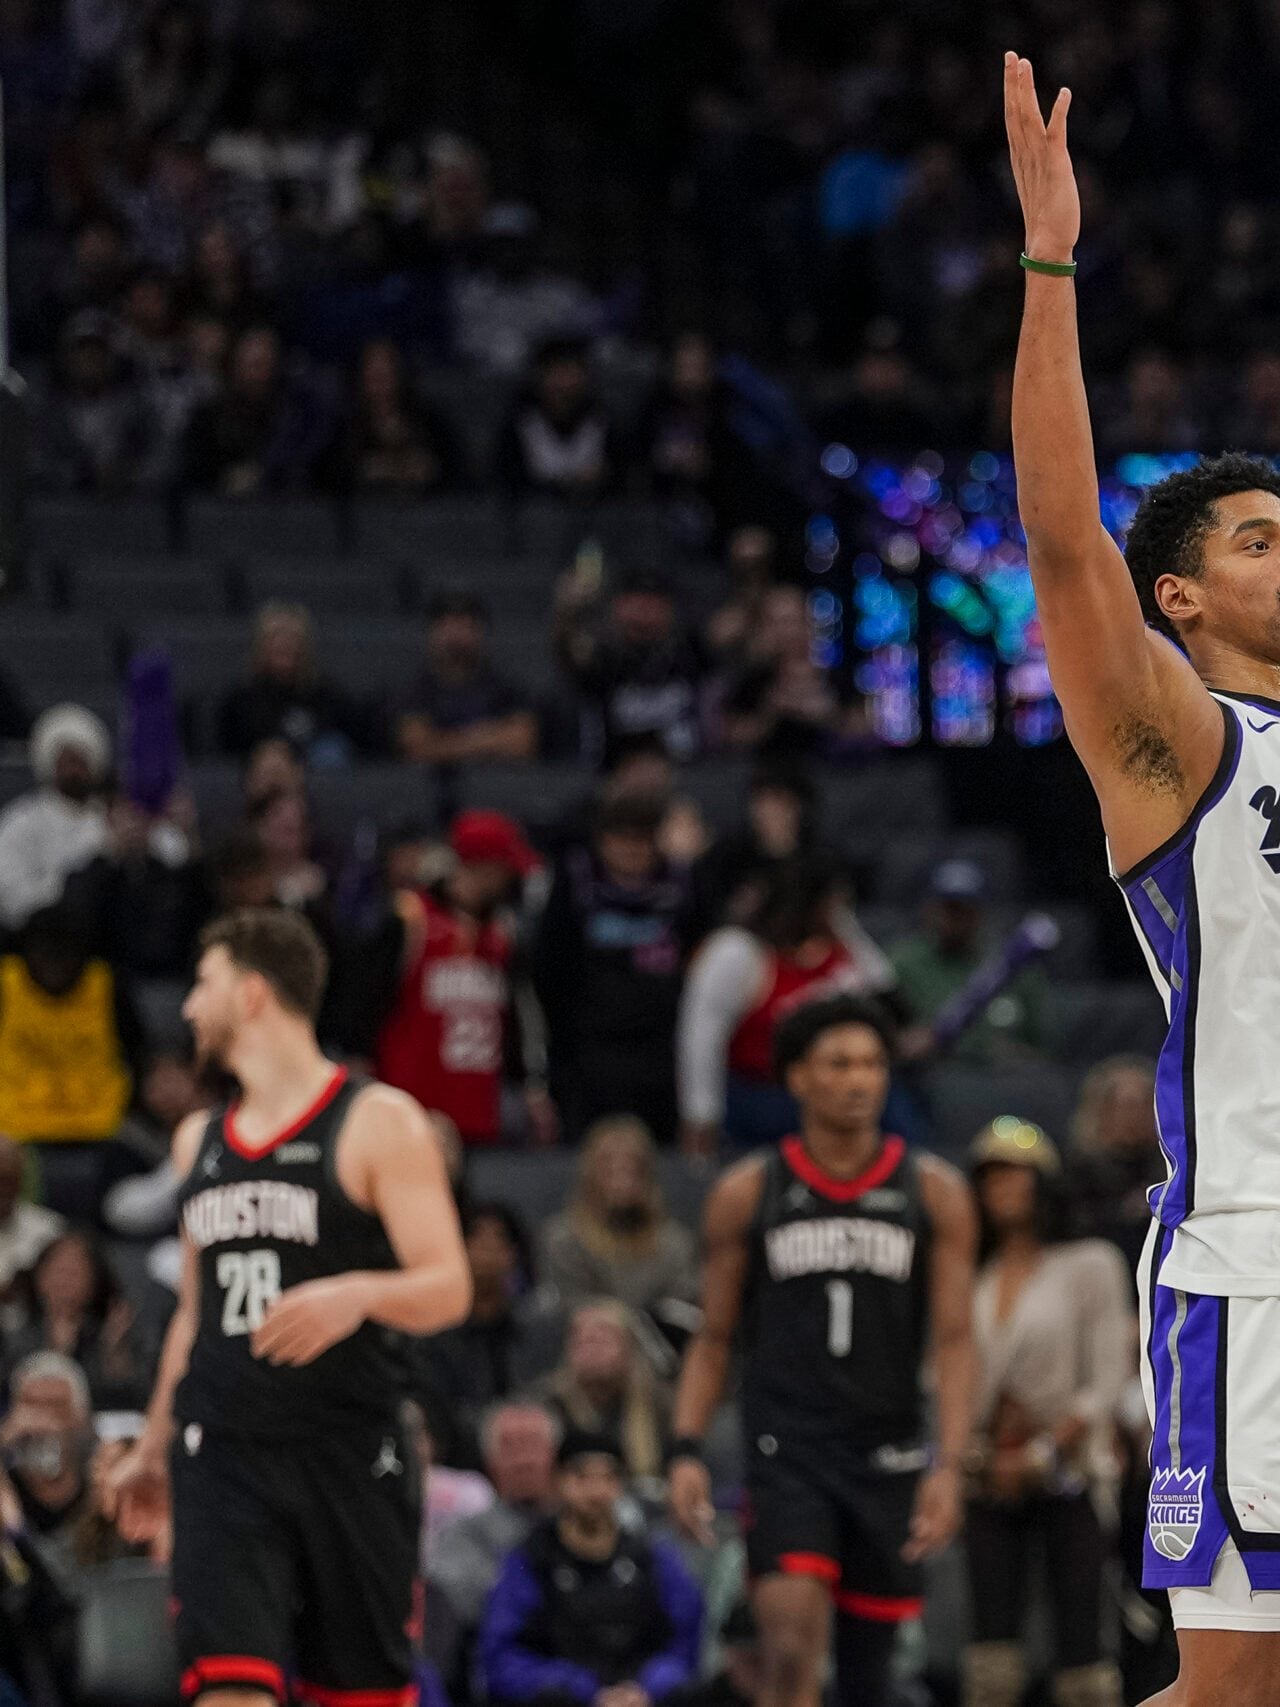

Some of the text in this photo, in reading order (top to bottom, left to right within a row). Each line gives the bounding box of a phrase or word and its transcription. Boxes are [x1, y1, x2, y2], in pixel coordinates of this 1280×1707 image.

[183, 1180, 319, 1247] HOUSTON
[765, 1217, 915, 1283] HOUSTON
[825, 1279, 853, 1357] 1
[1150, 1506, 1200, 1524] KINGS
[1152, 1494, 1198, 1503] SACRAMENTO
